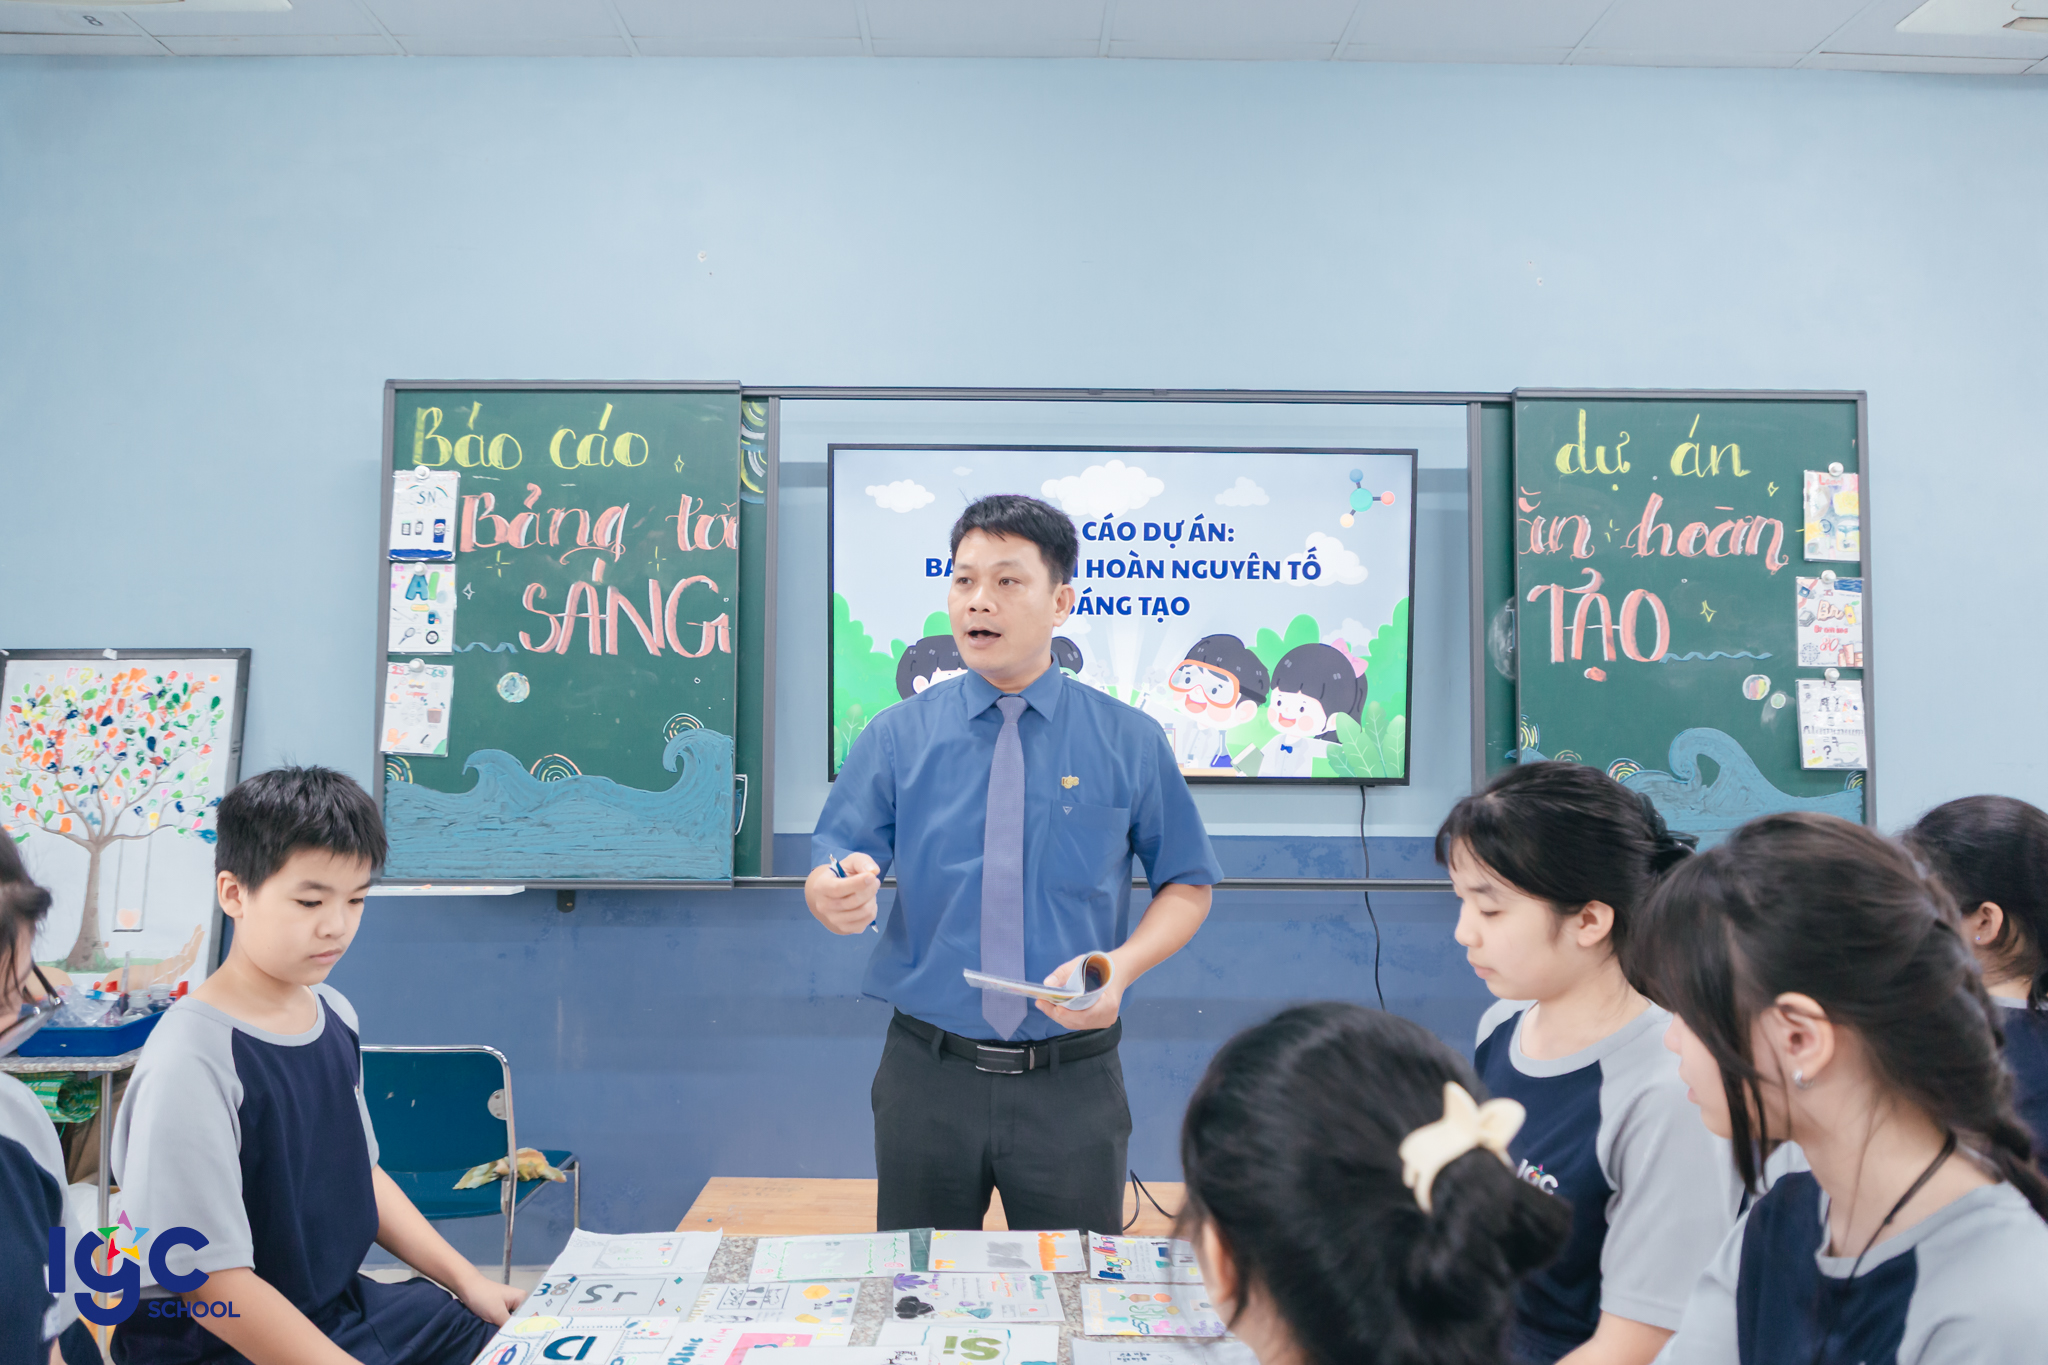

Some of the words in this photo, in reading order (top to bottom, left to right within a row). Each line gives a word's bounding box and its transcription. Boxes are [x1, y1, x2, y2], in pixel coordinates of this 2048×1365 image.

[412, 401, 523, 470] Báo
[549, 403, 649, 470] cáo
[1556, 408, 1631, 491] dự
[1670, 413, 1751, 478] án
[460, 482, 630, 565] Bảng
[1082, 512, 1137, 541] CÁO
[1143, 520, 1185, 549] DỰ
[1188, 513, 1234, 542] ÁN:
[1086, 550, 1164, 578] HOÀN
[1172, 552, 1280, 580] NGUYÊN
[1287, 546, 1321, 580] TỐ
[518, 557, 732, 658] SÁNG
[1138, 596, 1190, 623] TẠO
[1527, 567, 1671, 682] TẠO
[1819, 637, 1839, 652] 80
[534, 1282, 572, 1297] 38
[578, 1283, 638, 1304] Sr
